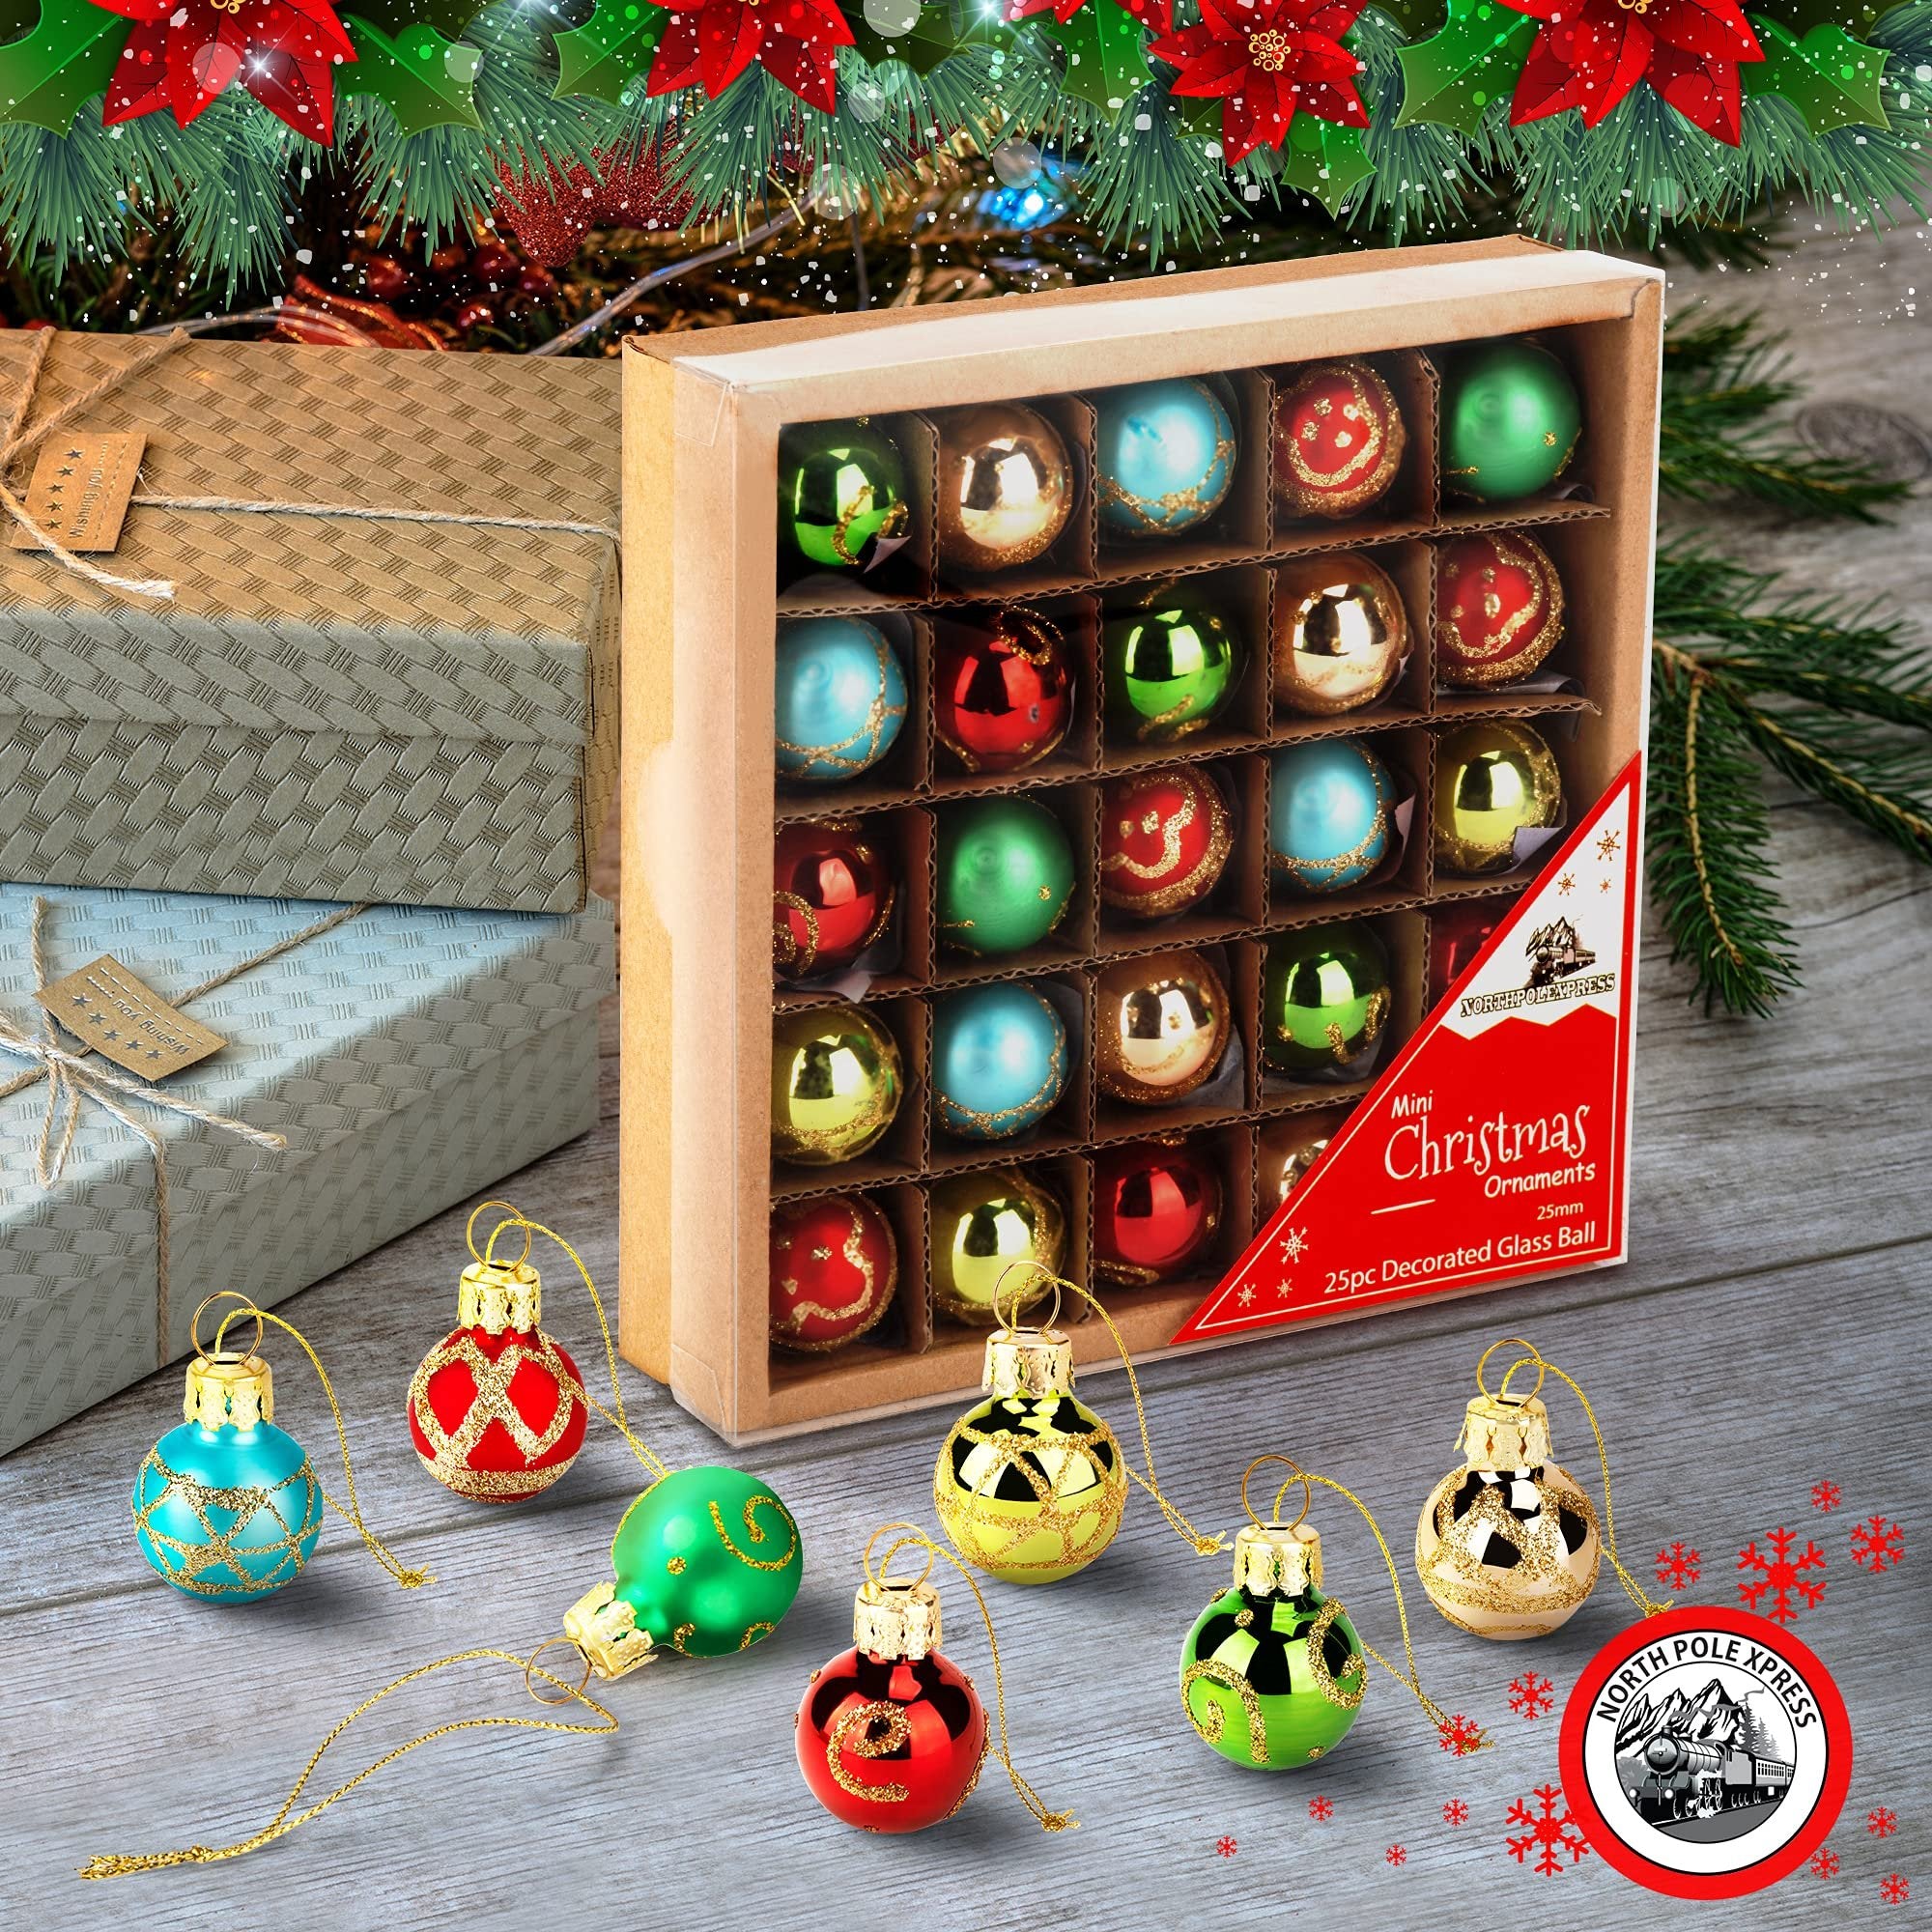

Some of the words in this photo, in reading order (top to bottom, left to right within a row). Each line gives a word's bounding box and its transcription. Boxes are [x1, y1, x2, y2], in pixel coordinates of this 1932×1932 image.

[69, 490, 100, 539] Wishing
[88, 467, 103, 489] you
[111, 998, 144, 1021] you
[139, 1019, 190, 1055] Wishing
[1391, 1090, 1434, 1119] Mini
[1384, 1104, 1591, 1180] Christmas
[1484, 1161, 1596, 1198] Ornaments
[1536, 1202, 1584, 1221] 25mm
[1323, 1267, 1376, 1294] 25pc
[1381, 1239, 1492, 1283] Decorated
[1496, 1234, 1552, 1259] Glass
[1557, 1220, 1596, 1248] Ball
